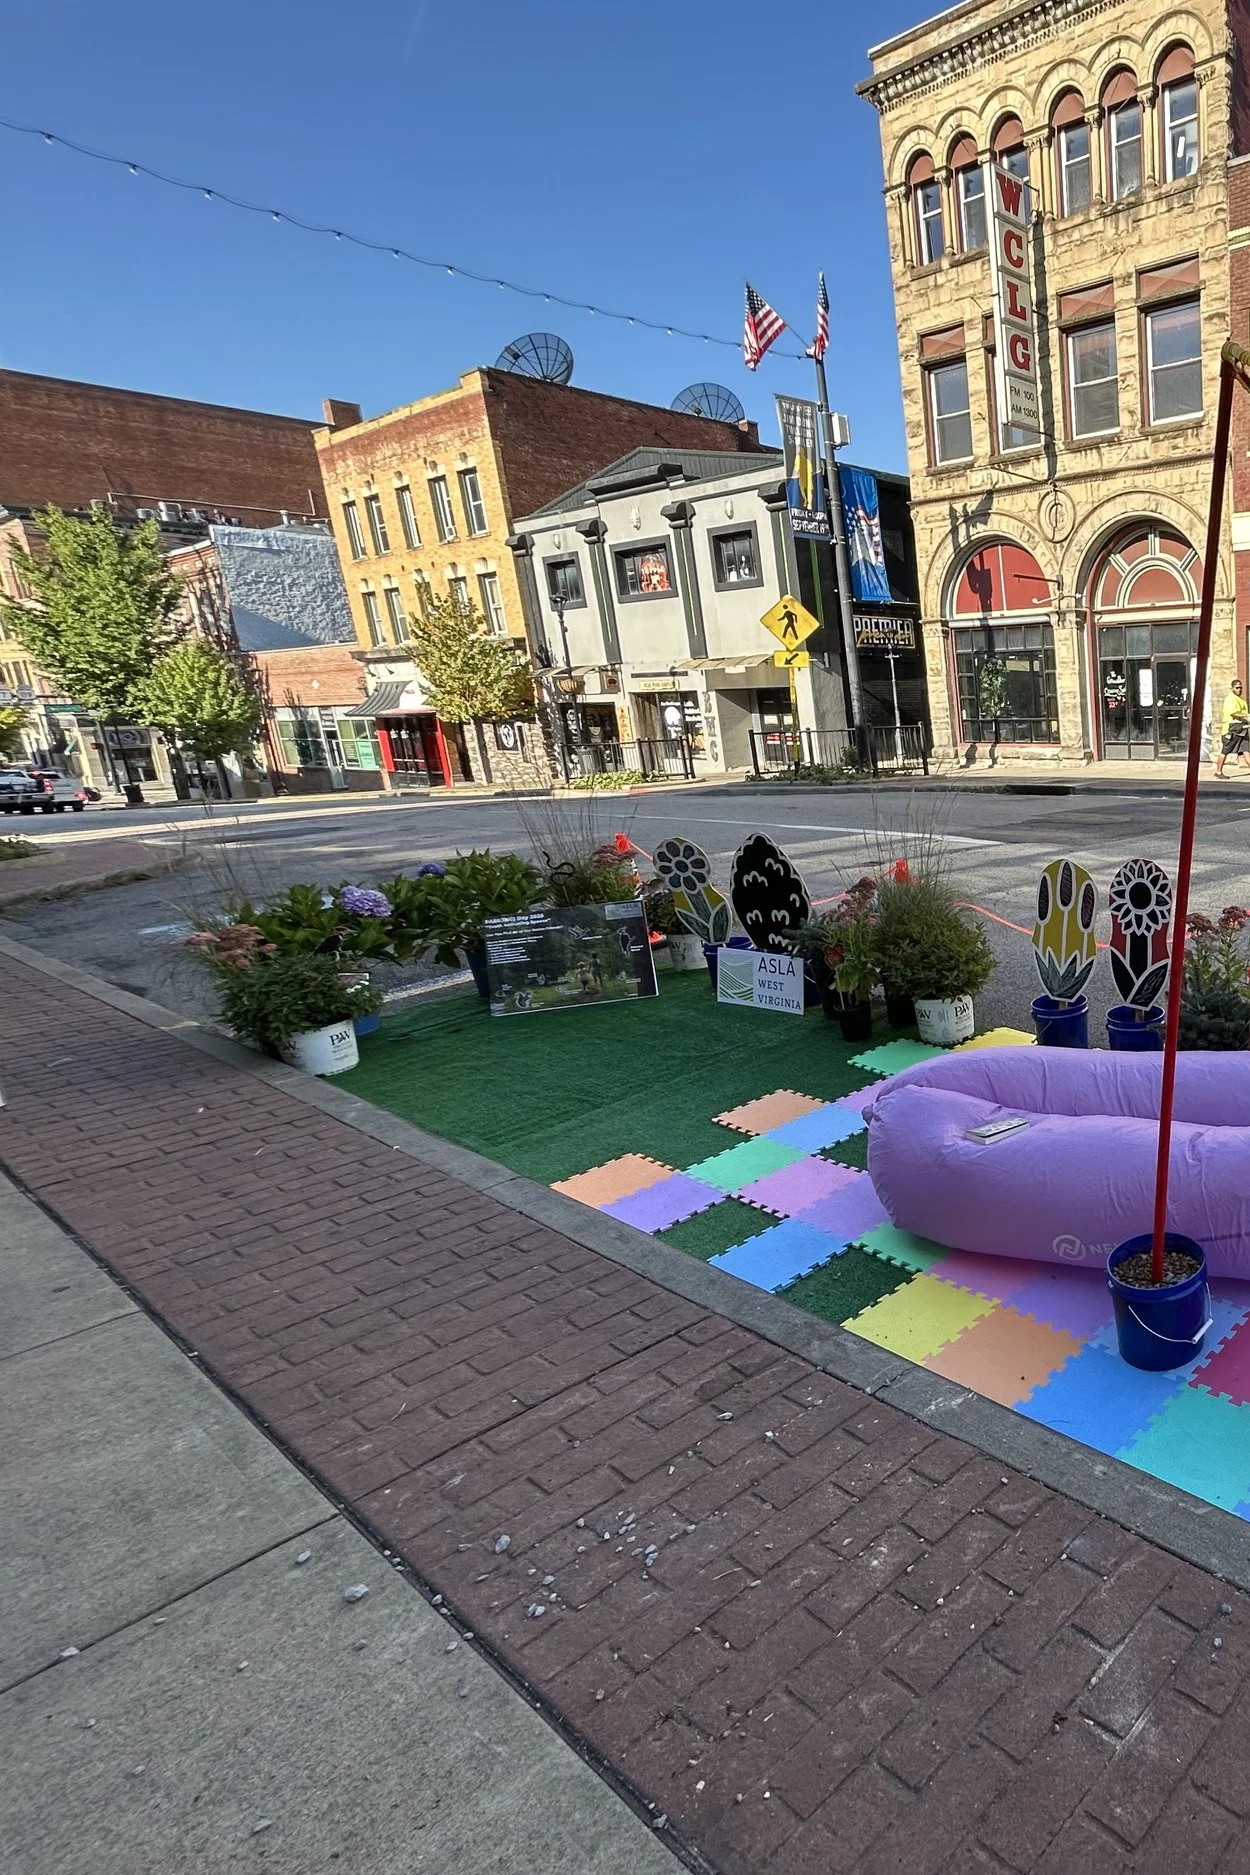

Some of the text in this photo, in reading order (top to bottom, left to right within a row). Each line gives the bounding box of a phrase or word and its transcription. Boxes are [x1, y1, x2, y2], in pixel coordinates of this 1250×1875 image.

[996, 173, 1031, 372] WCLG
[1010, 386, 1035, 402] FM 100
[1011, 404, 1038, 419] AM 1300
[758, 956, 796, 977] ASLA
[758, 979, 785, 991] WEST
[758, 994, 802, 1010] VIRGINIA
